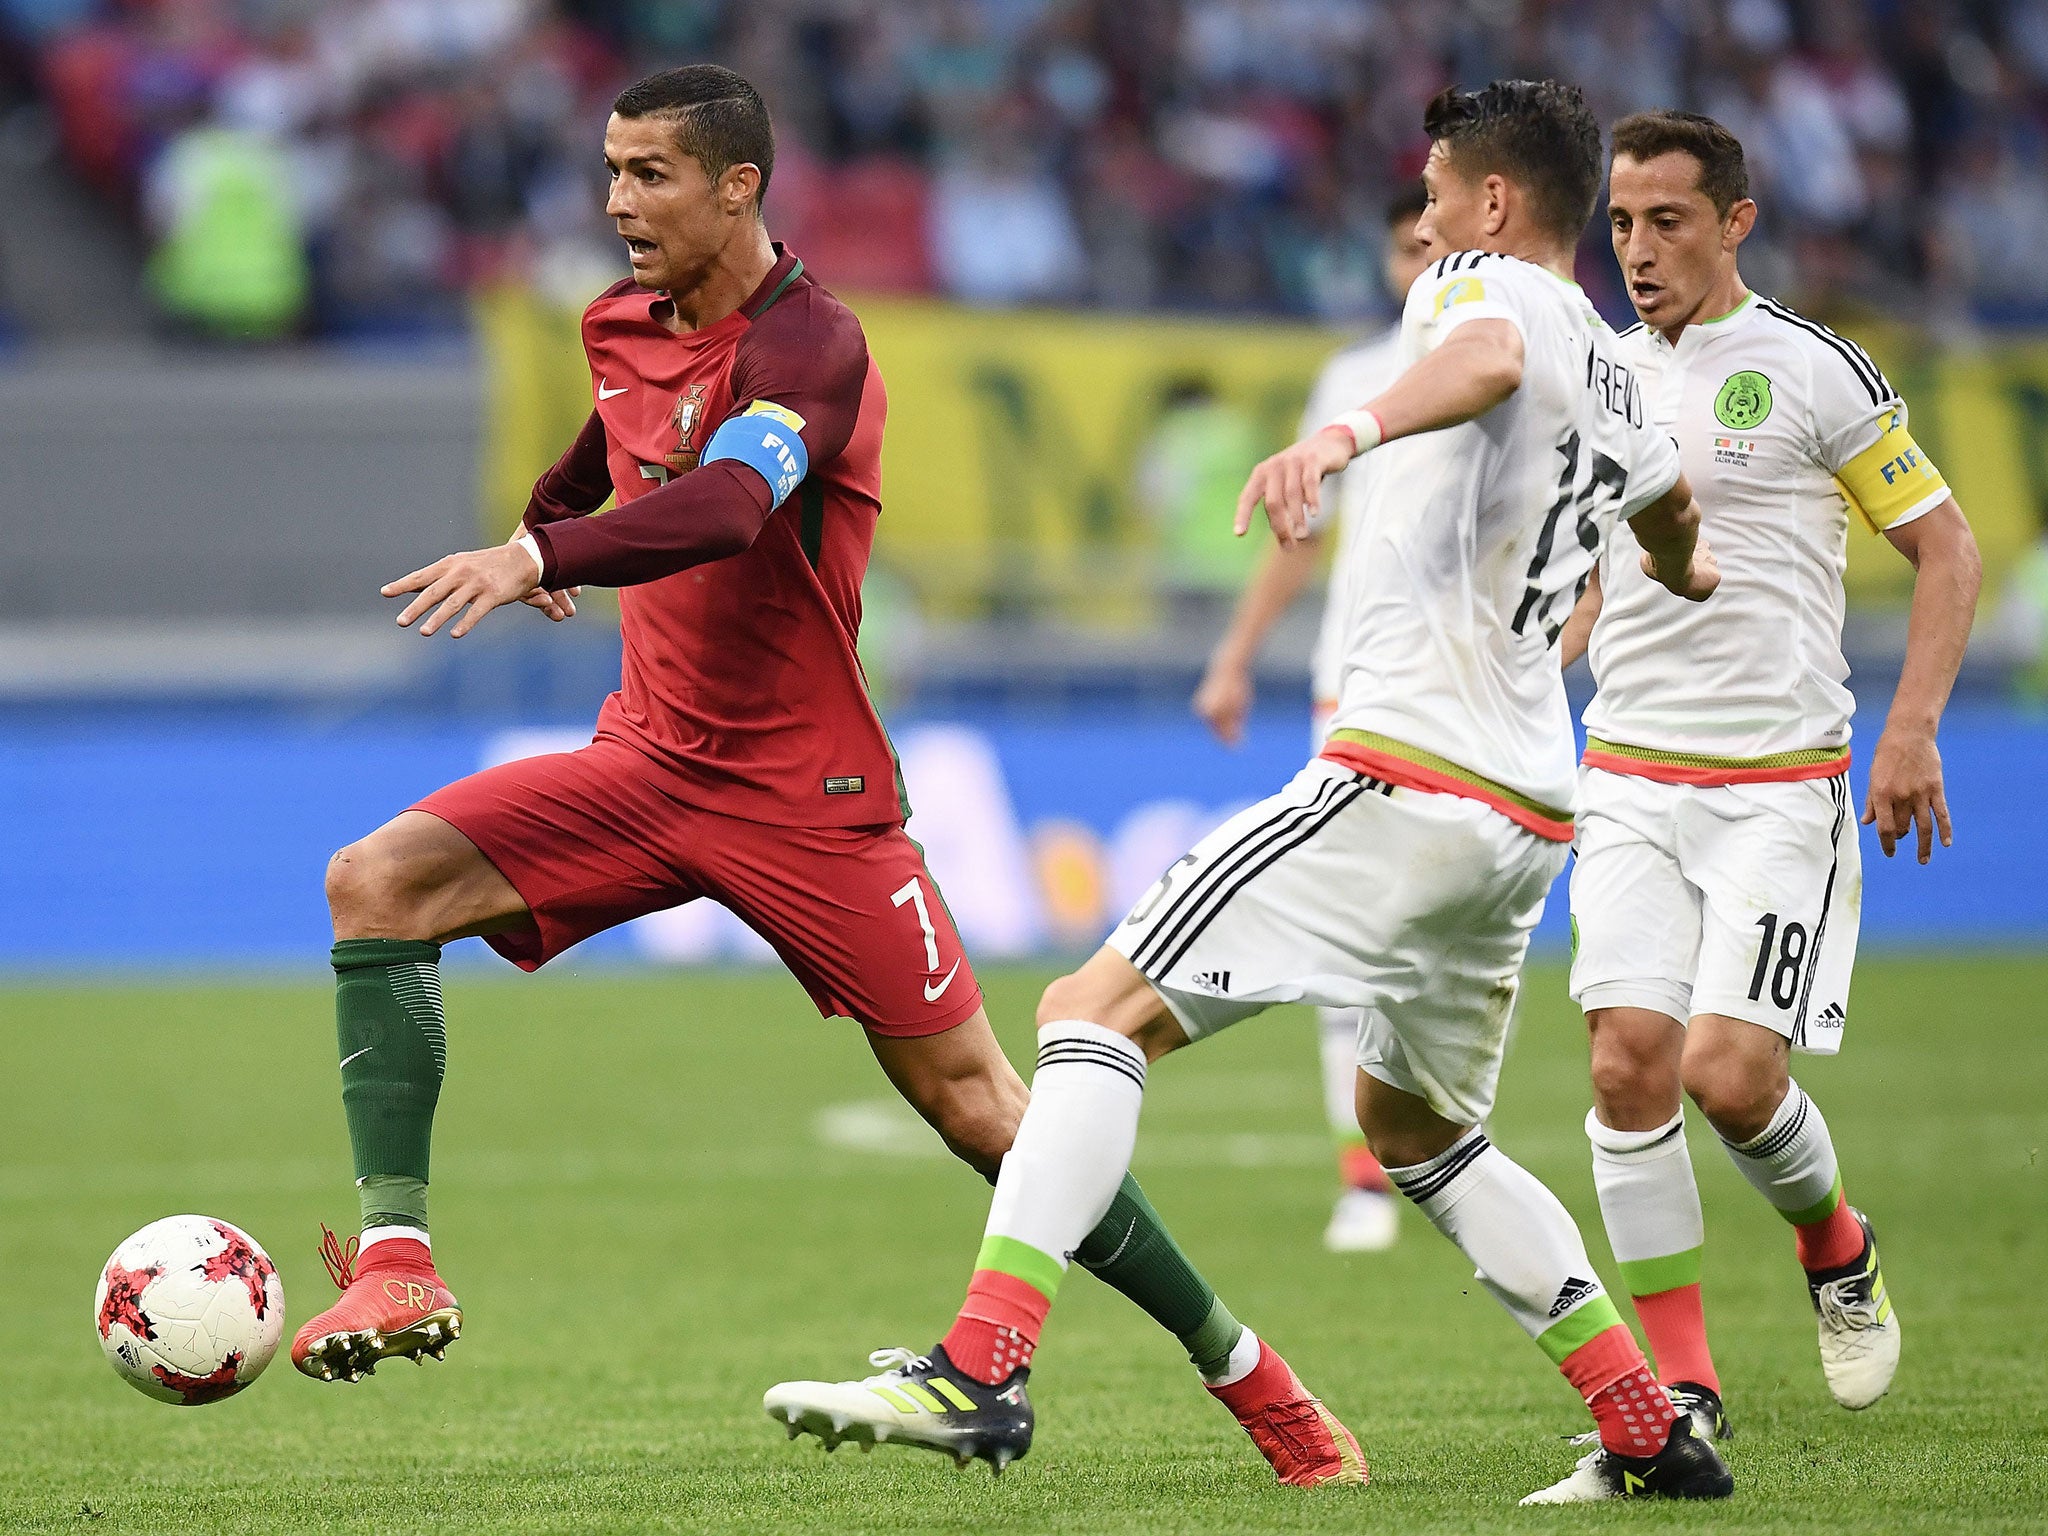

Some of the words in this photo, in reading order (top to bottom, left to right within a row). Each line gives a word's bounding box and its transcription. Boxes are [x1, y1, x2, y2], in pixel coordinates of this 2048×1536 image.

[761, 432, 798, 491] FIFA
[890, 876, 940, 972] 7
[1747, 912, 1807, 1010] 18
[383, 1279, 436, 1312] CR7
[1548, 1283, 1599, 1318] adidas
